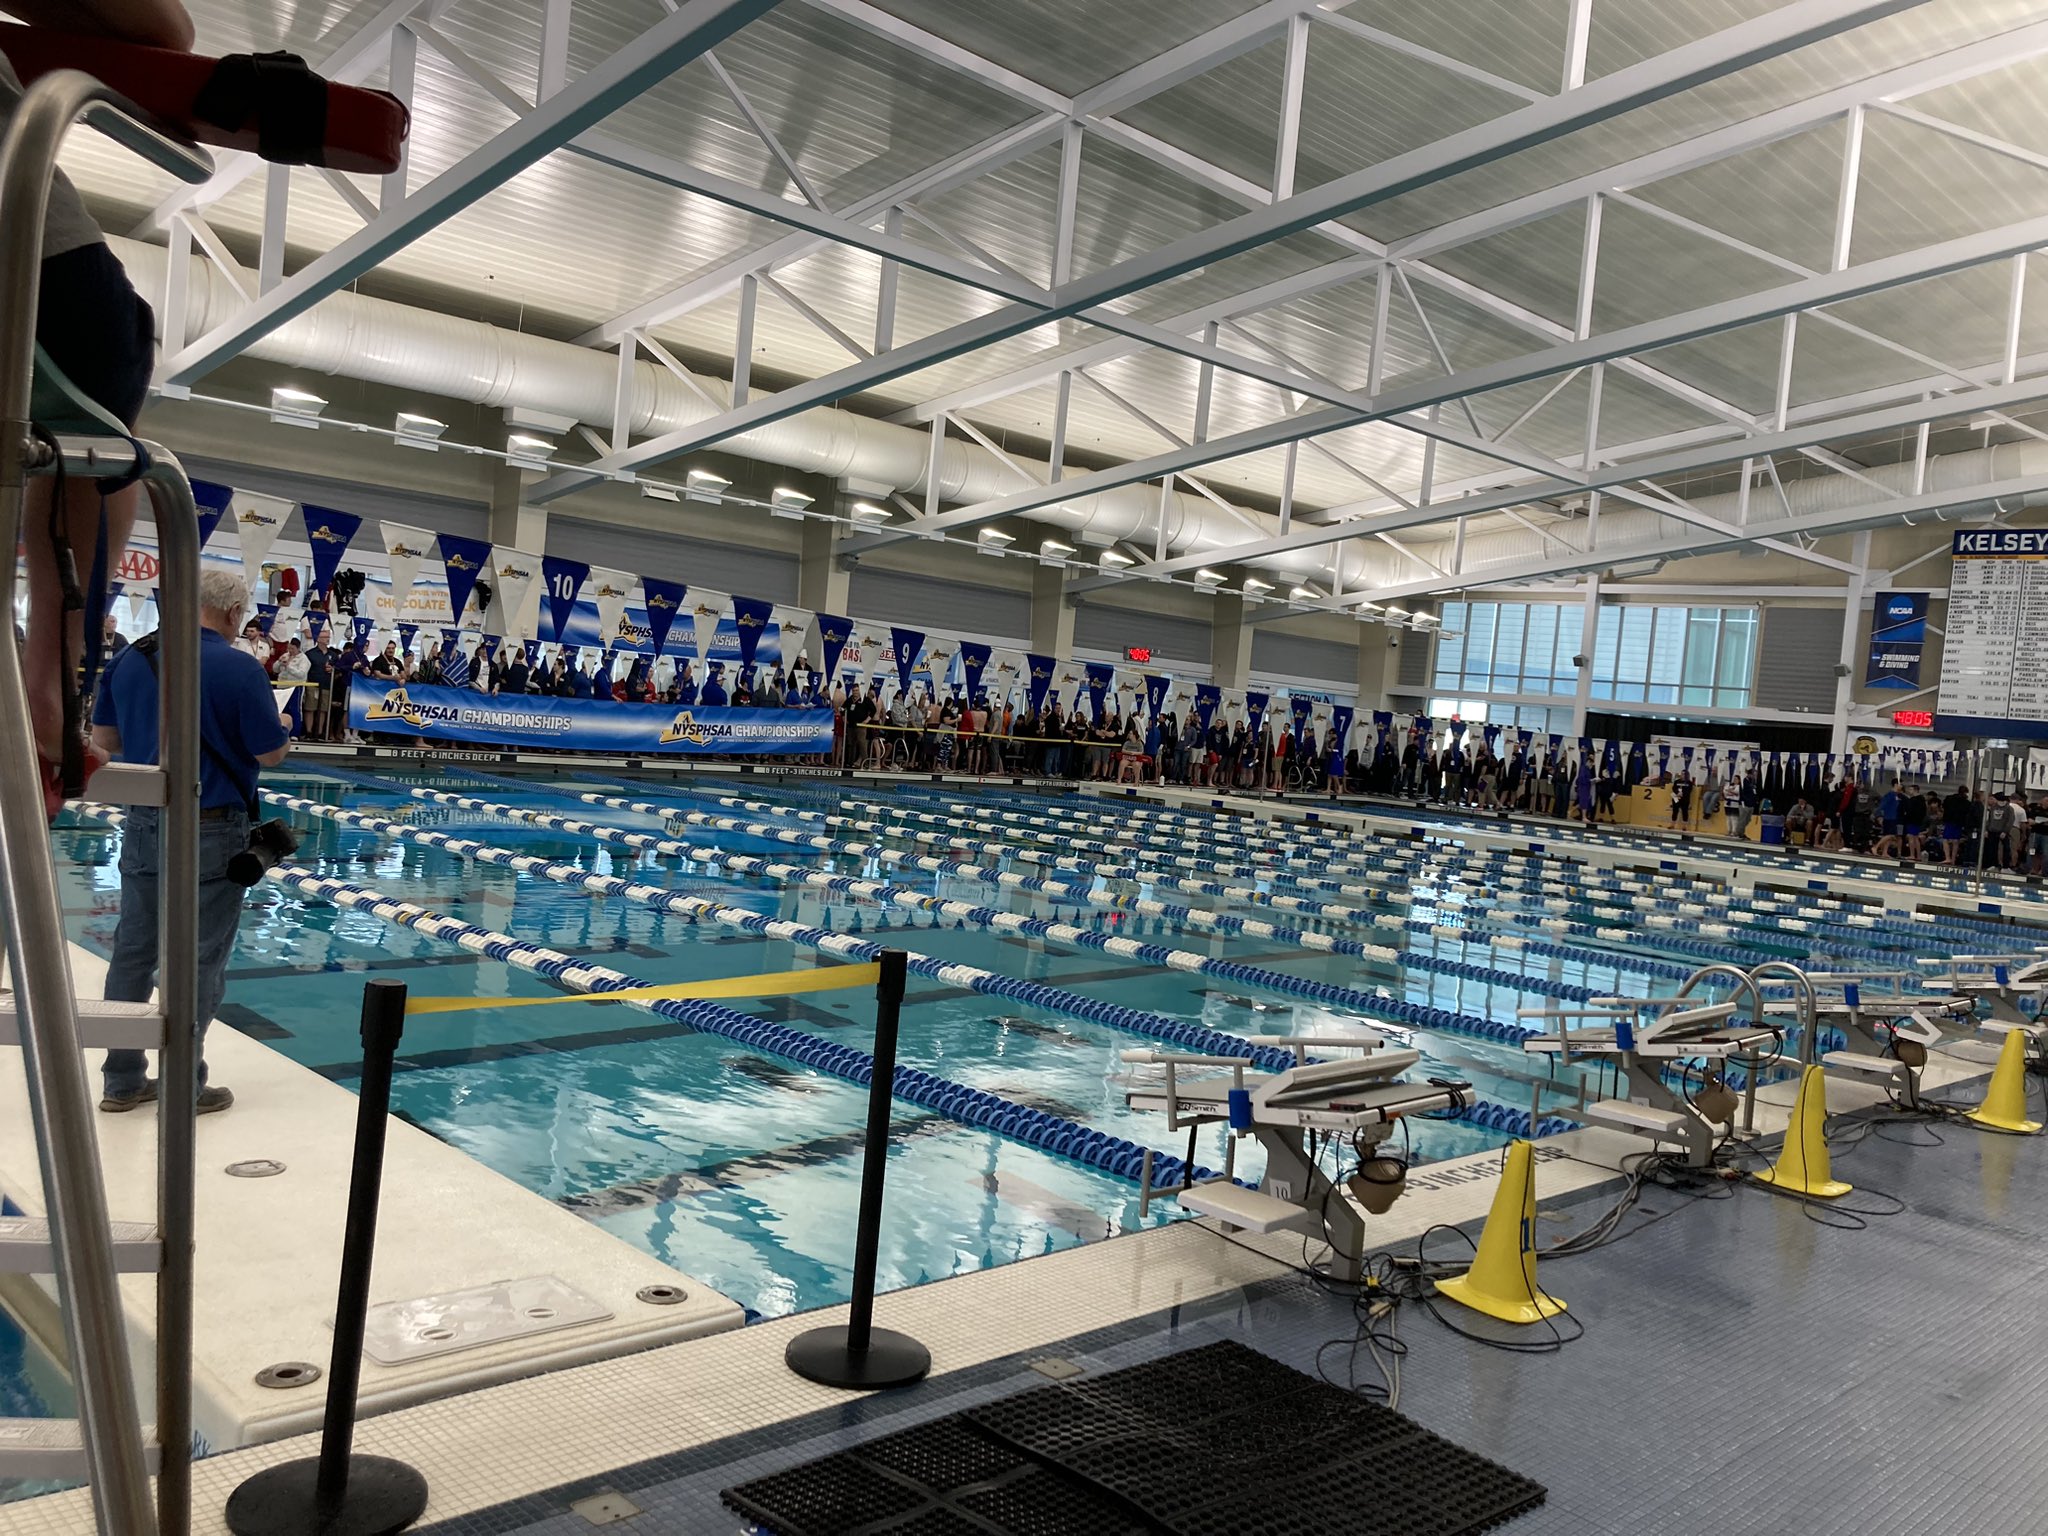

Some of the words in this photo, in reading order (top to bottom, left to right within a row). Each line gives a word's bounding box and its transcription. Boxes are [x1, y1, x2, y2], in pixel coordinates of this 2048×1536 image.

[1959, 533, 2048, 551] KELSEY
[553, 573, 574, 601] 10
[1889, 607, 1913, 615] NCAA
[529, 645, 535, 656] 7
[902, 643, 910, 663] 9
[1881, 654, 1920, 662] SWIMMING
[1885, 661, 1909, 669] DIVING
[1152, 687, 1159, 705] 8
[381, 700, 458, 722] NYSPHSAA
[463, 709, 572, 731] CHAMPIONSHIPS
[672, 723, 732, 737] NYSPHSAA
[735, 725, 821, 738] CHAMPIONSHIPS
[1339, 715, 1346, 732] 7
[401, 750, 426, 758] FEET
[438, 753, 470, 761] INCHES
[472, 754, 496, 762] DEEP
[1609, 748, 1615, 762] 5
[1644, 788, 1653, 800] 2
[1190, 1104, 1217, 1112] Smith
[1275, 1185, 1288, 1201] 10
